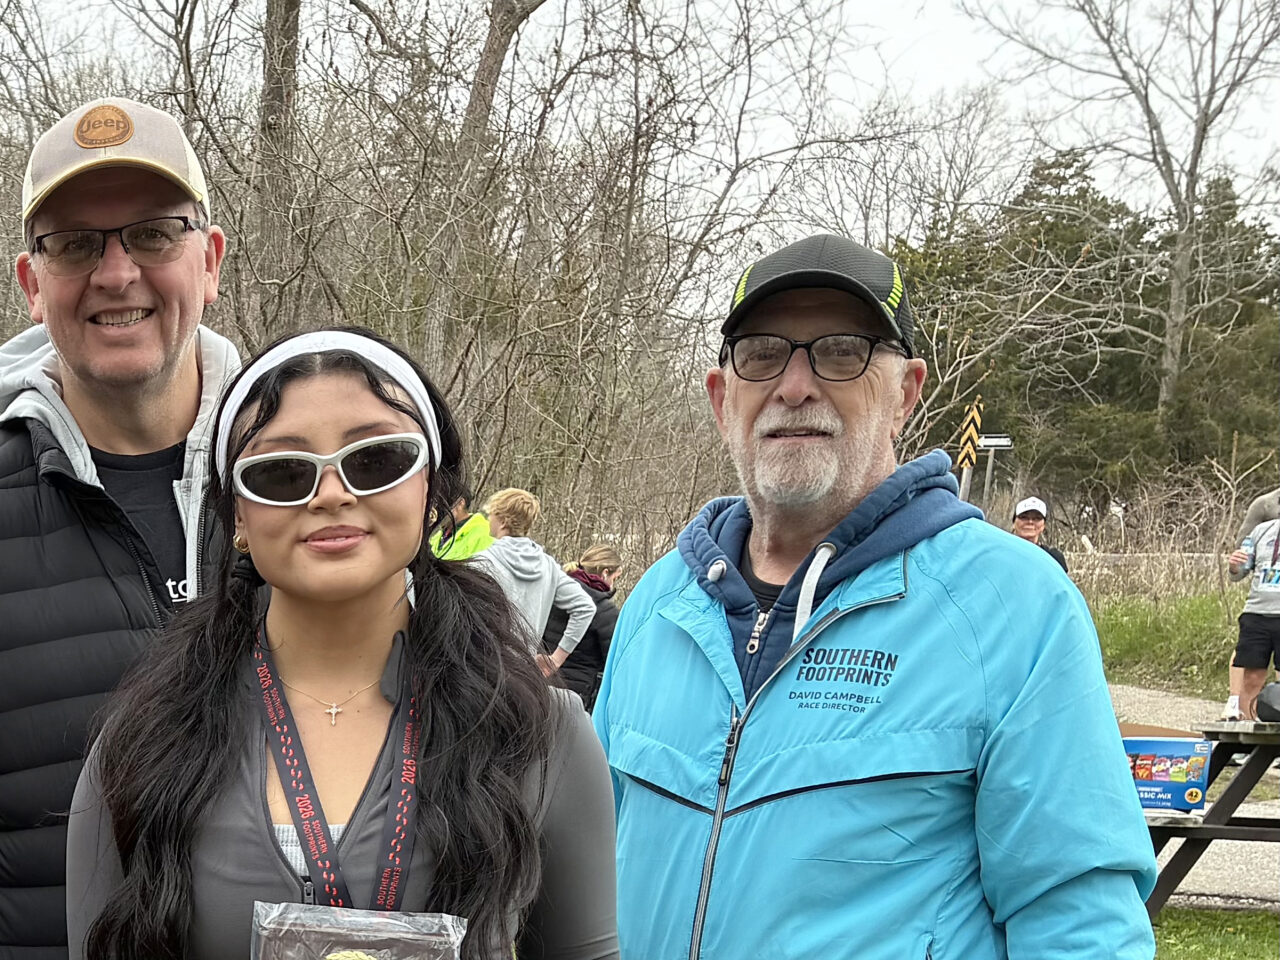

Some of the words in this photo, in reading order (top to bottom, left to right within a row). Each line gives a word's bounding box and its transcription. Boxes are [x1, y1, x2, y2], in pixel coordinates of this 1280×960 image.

[80, 118, 128, 133] Jeep
[802, 647, 899, 672] SOUTHERN
[256, 662, 273, 689] 2026
[796, 666, 893, 687] FOOTPRINTS
[788, 691, 822, 700] DAVID
[824, 691, 882, 705] CAMPBELL
[821, 702, 866, 714] DIRECTOR
[401, 759, 416, 785] 2026
[295, 793, 315, 820] 2026
[1140, 791, 1155, 799] SSIC
[302, 820, 320, 860] FOOTPRINTS
[311, 819, 328, 854] SOUTHERN
[377, 867, 391, 905] SOUTHERN
[386, 866, 402, 911] FOOTPRINTS
